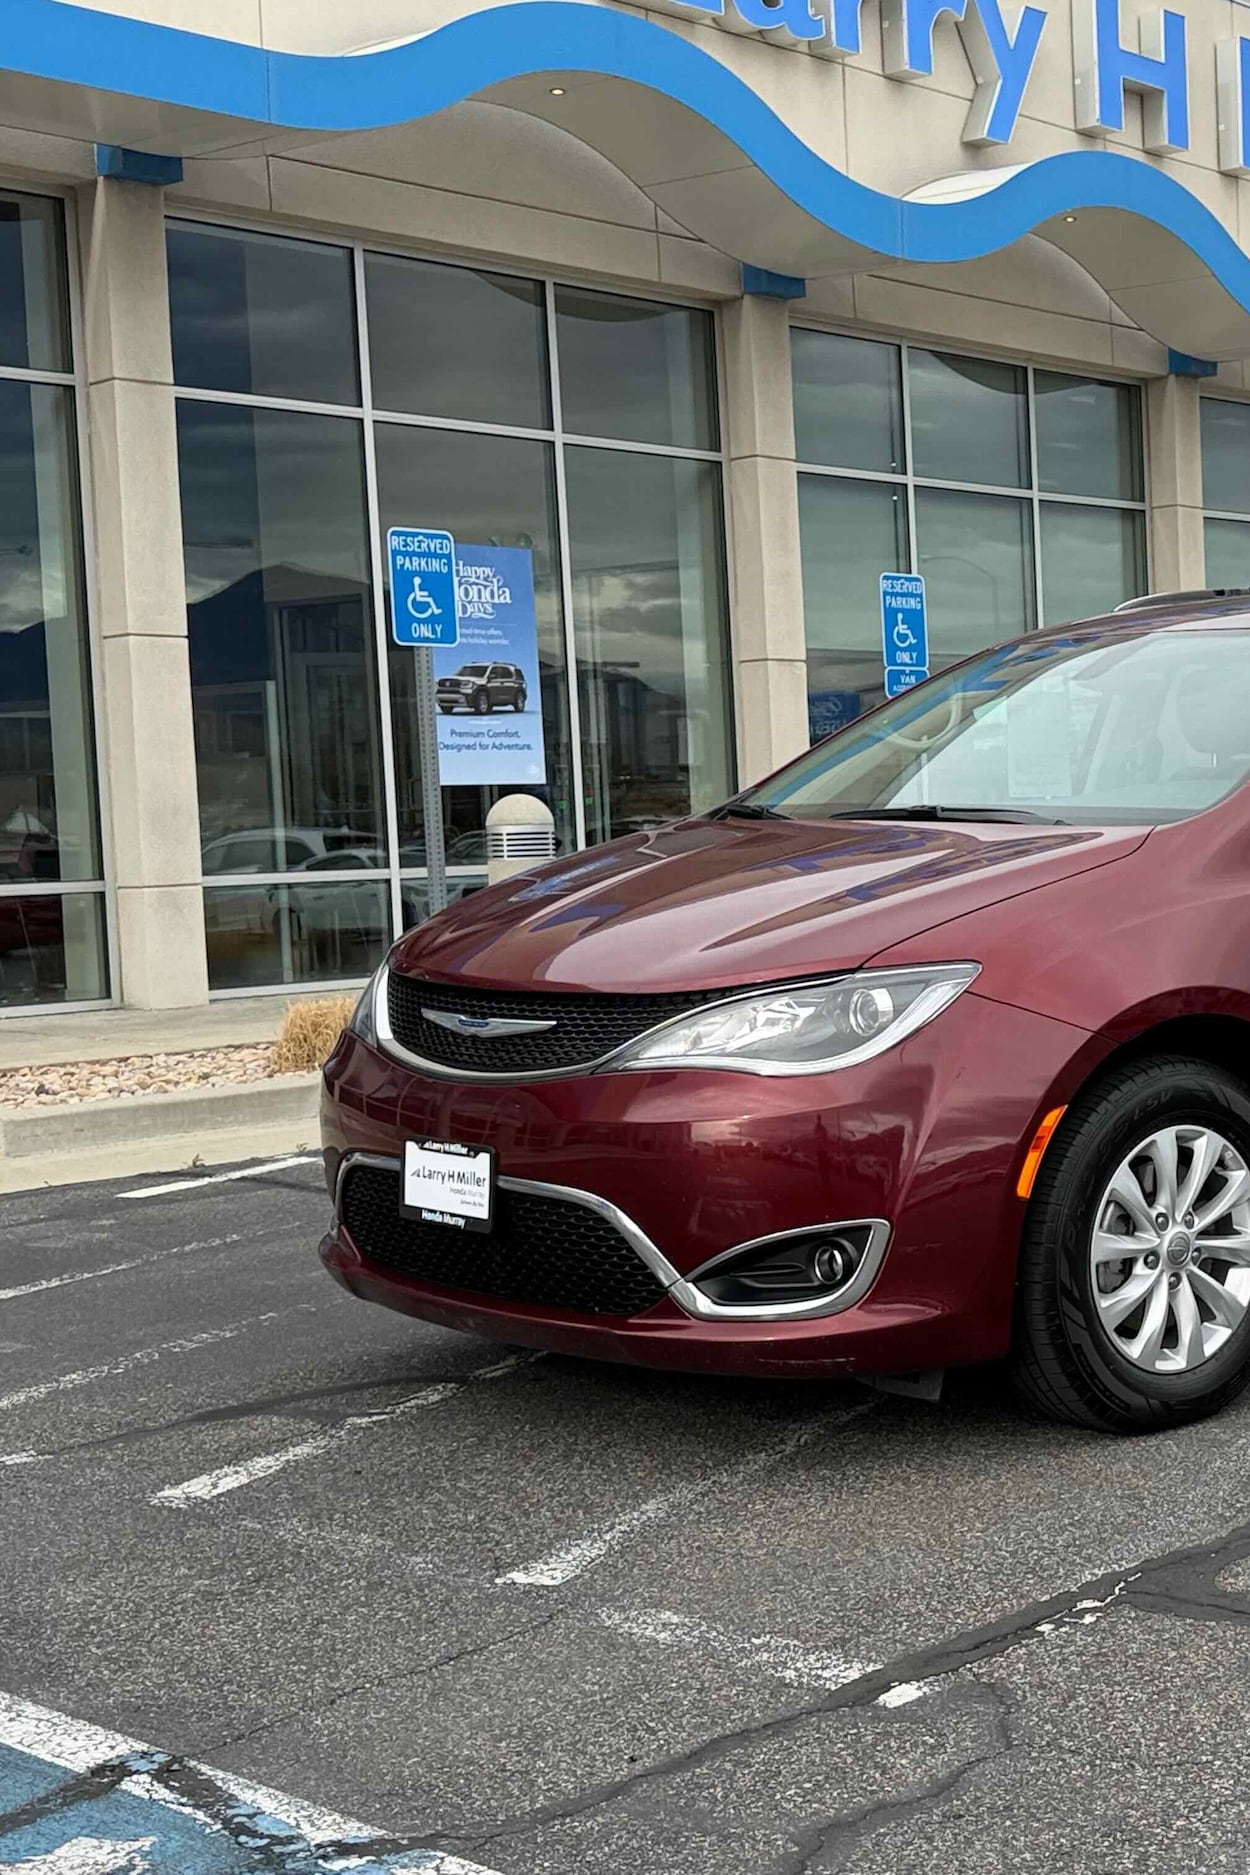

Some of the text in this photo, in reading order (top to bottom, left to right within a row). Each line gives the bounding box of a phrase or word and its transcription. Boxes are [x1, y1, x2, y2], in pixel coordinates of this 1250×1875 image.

[1093, 0, 1189, 151] H
[391, 535, 451, 554] RESERVED
[396, 555, 449, 574] PARKING
[882, 579, 923, 594] RESERVED
[457, 602, 496, 619] Days
[885, 596, 922, 610] PARKING
[411, 622, 443, 639] ONLY
[895, 651, 918, 664] ONLY
[900, 674, 916, 684] VAN
[450, 728, 486, 738] Premium
[439, 741, 533, 753] Designed for Adventure.
[422, 1165, 486, 1188] Larry H Miller
[421, 1209, 466, 1230] Honda Murray
